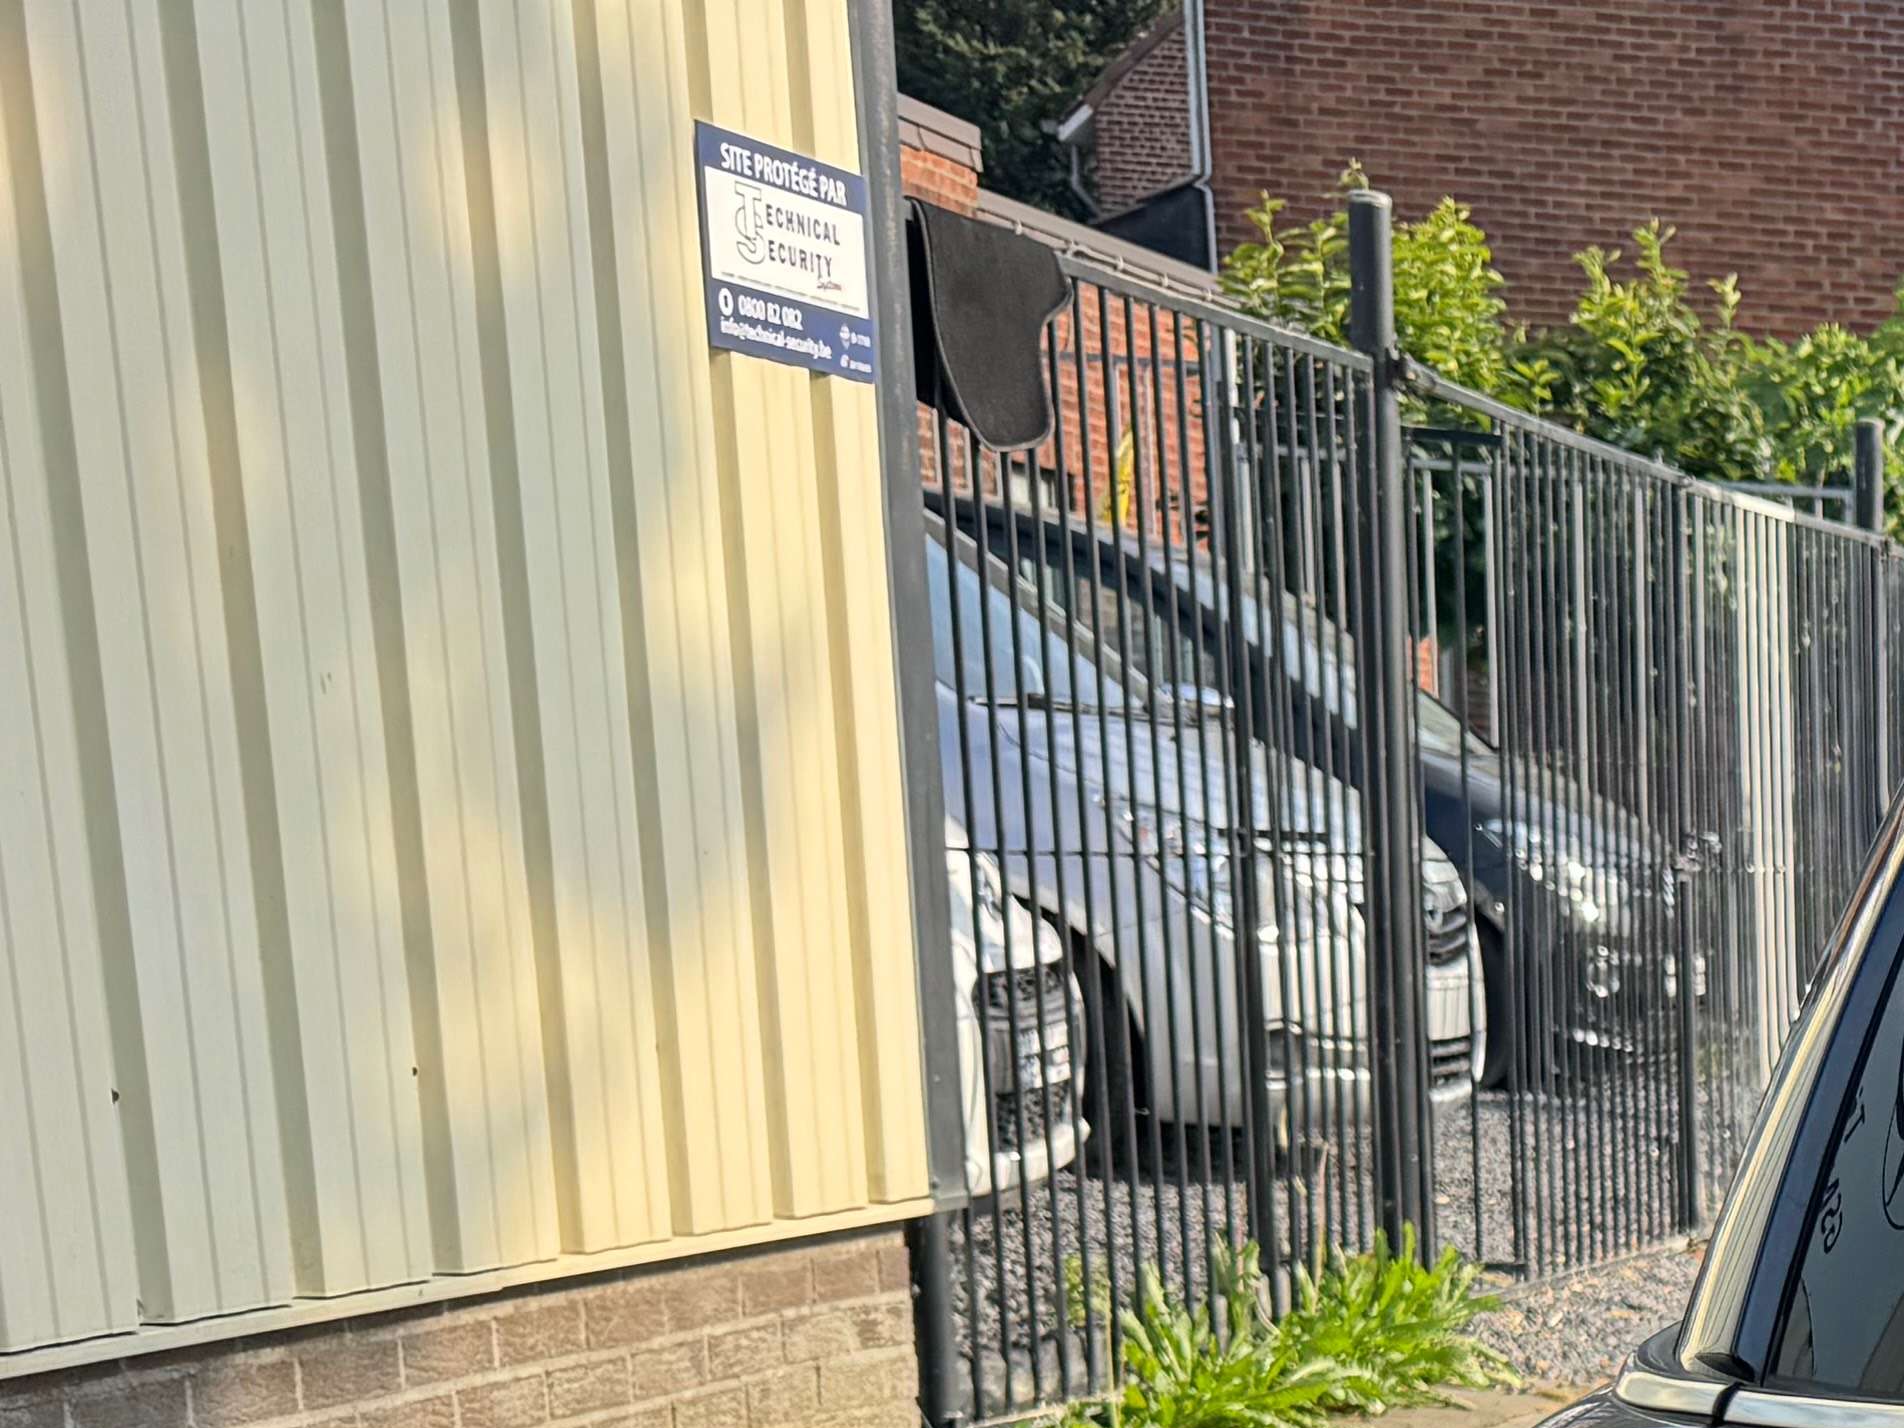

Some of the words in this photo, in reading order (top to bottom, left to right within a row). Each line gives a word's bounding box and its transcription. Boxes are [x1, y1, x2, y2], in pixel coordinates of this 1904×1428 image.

[720, 142, 752, 177] SITE
[755, 153, 818, 198] PROTÉGÉ
[820, 177, 847, 207] PAR
